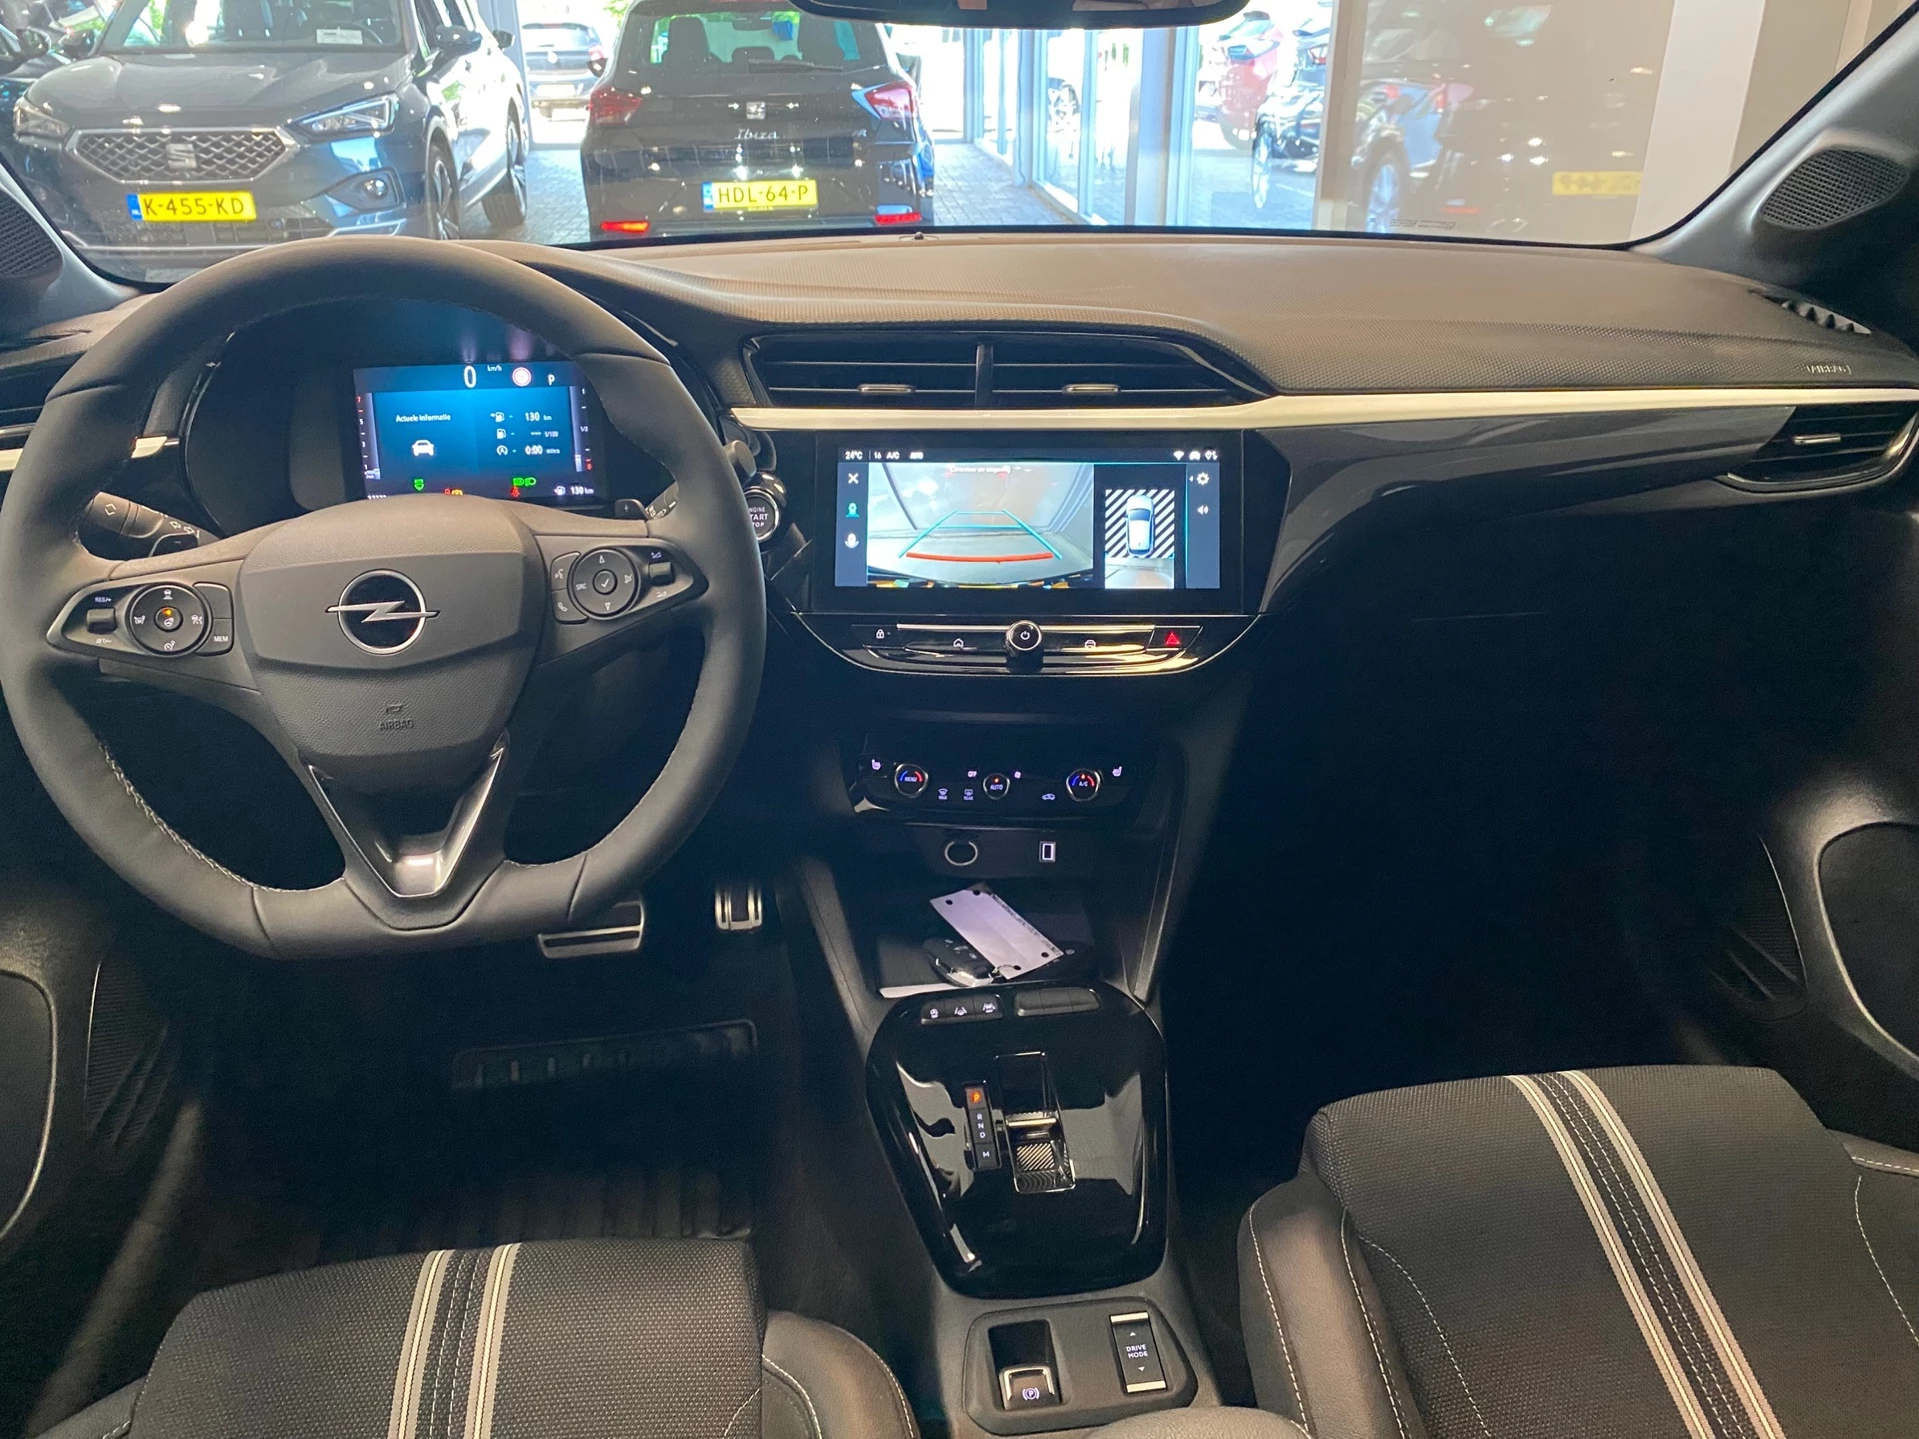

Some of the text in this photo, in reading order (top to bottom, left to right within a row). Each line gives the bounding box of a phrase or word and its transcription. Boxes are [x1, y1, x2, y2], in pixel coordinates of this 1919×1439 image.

[735, 128, 778, 140] Ibiza
[718, 184, 809, 204] HDL-64-P
[143, 197, 245, 216] K-455-KD
[463, 364, 502, 388] 0 km/h
[547, 374, 555, 386] P
[525, 412, 541, 421] 130
[524, 445, 543, 455] 0:00
[886, 451, 901, 460] A/C
[570, 486, 584, 495] 130
[750, 513, 768, 521] TART
[379, 720, 415, 731] AIRBAG
[972, 1091, 981, 1103] P
[976, 1113, 983, 1121] R
[978, 1122, 984, 1130] N
[979, 1131, 986, 1139] D
[1125, 1343, 1147, 1352] DRIVE
[1127, 1351, 1149, 1359] MODE
